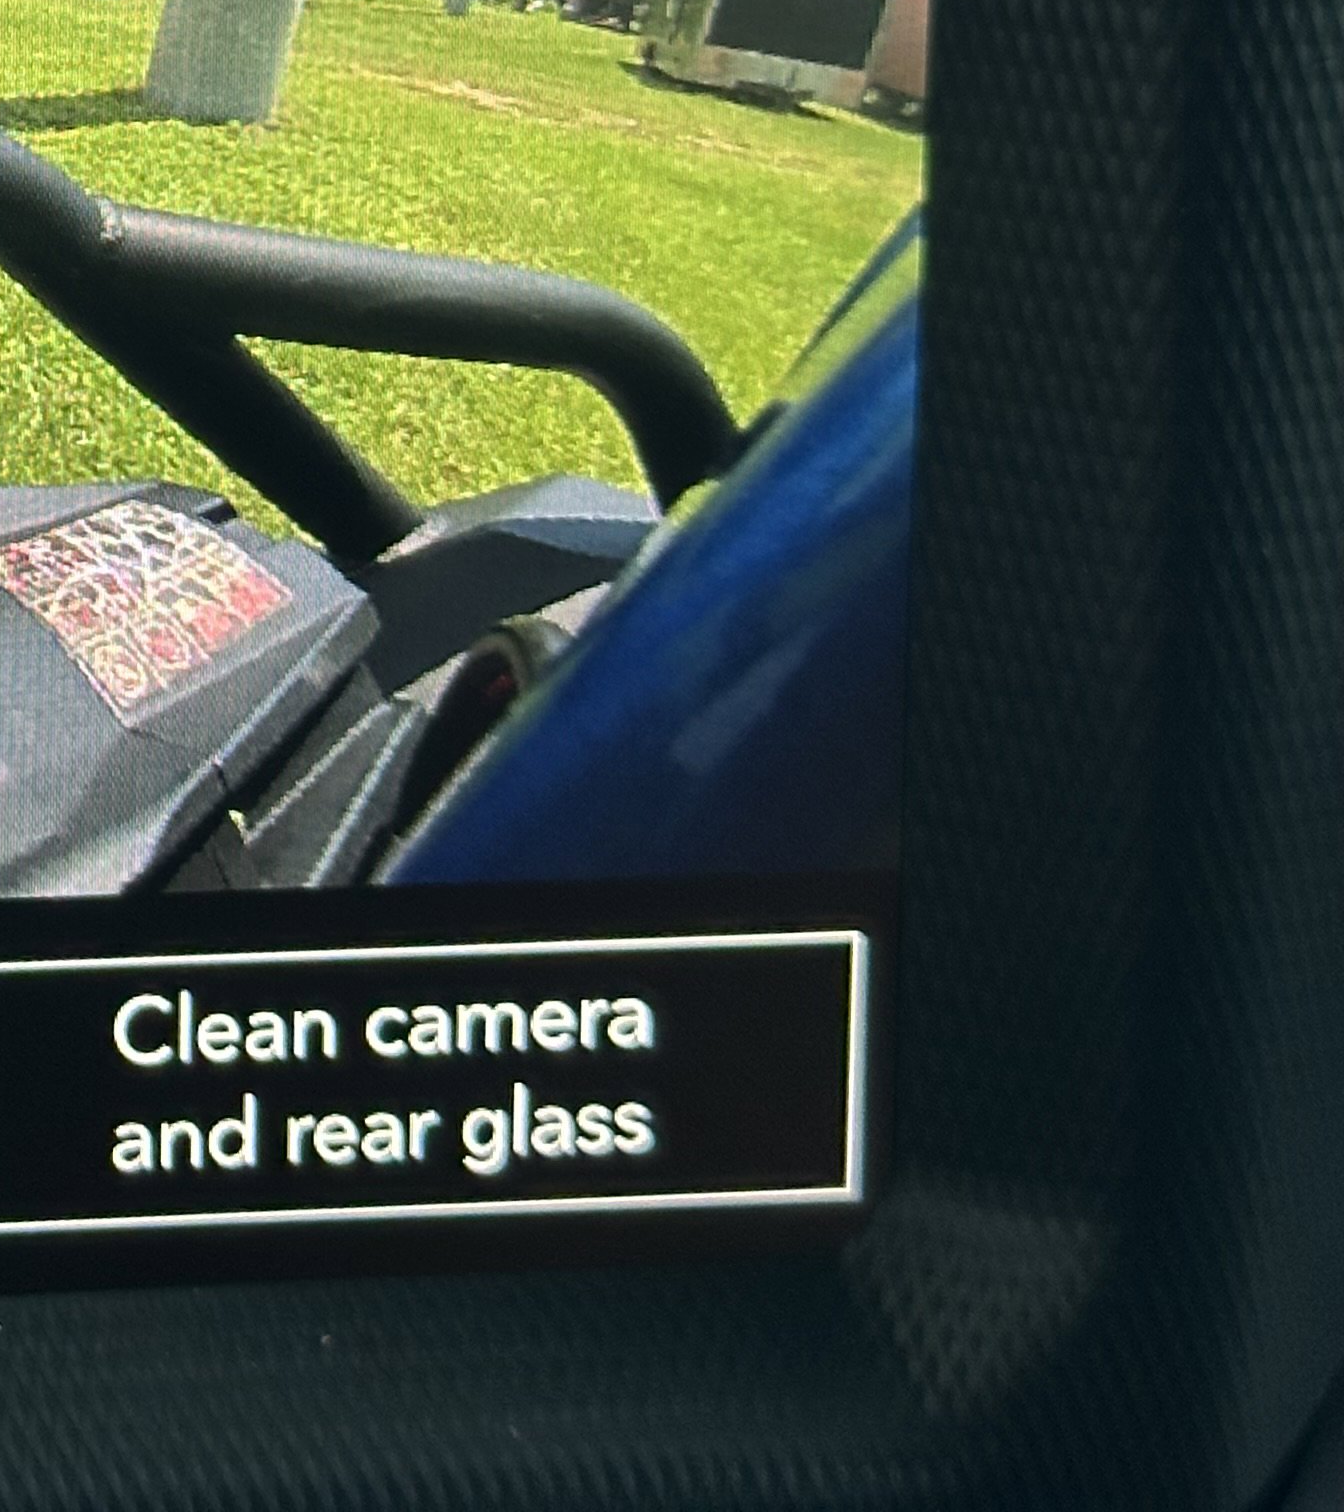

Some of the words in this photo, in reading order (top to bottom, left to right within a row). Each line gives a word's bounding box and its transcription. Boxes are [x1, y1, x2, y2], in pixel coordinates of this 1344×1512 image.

[112, 989, 339, 1067] Clean
[364, 996, 655, 1059] camera
[111, 1092, 259, 1174] and
[285, 1108, 442, 1166] rear
[461, 1081, 657, 1177] glass
